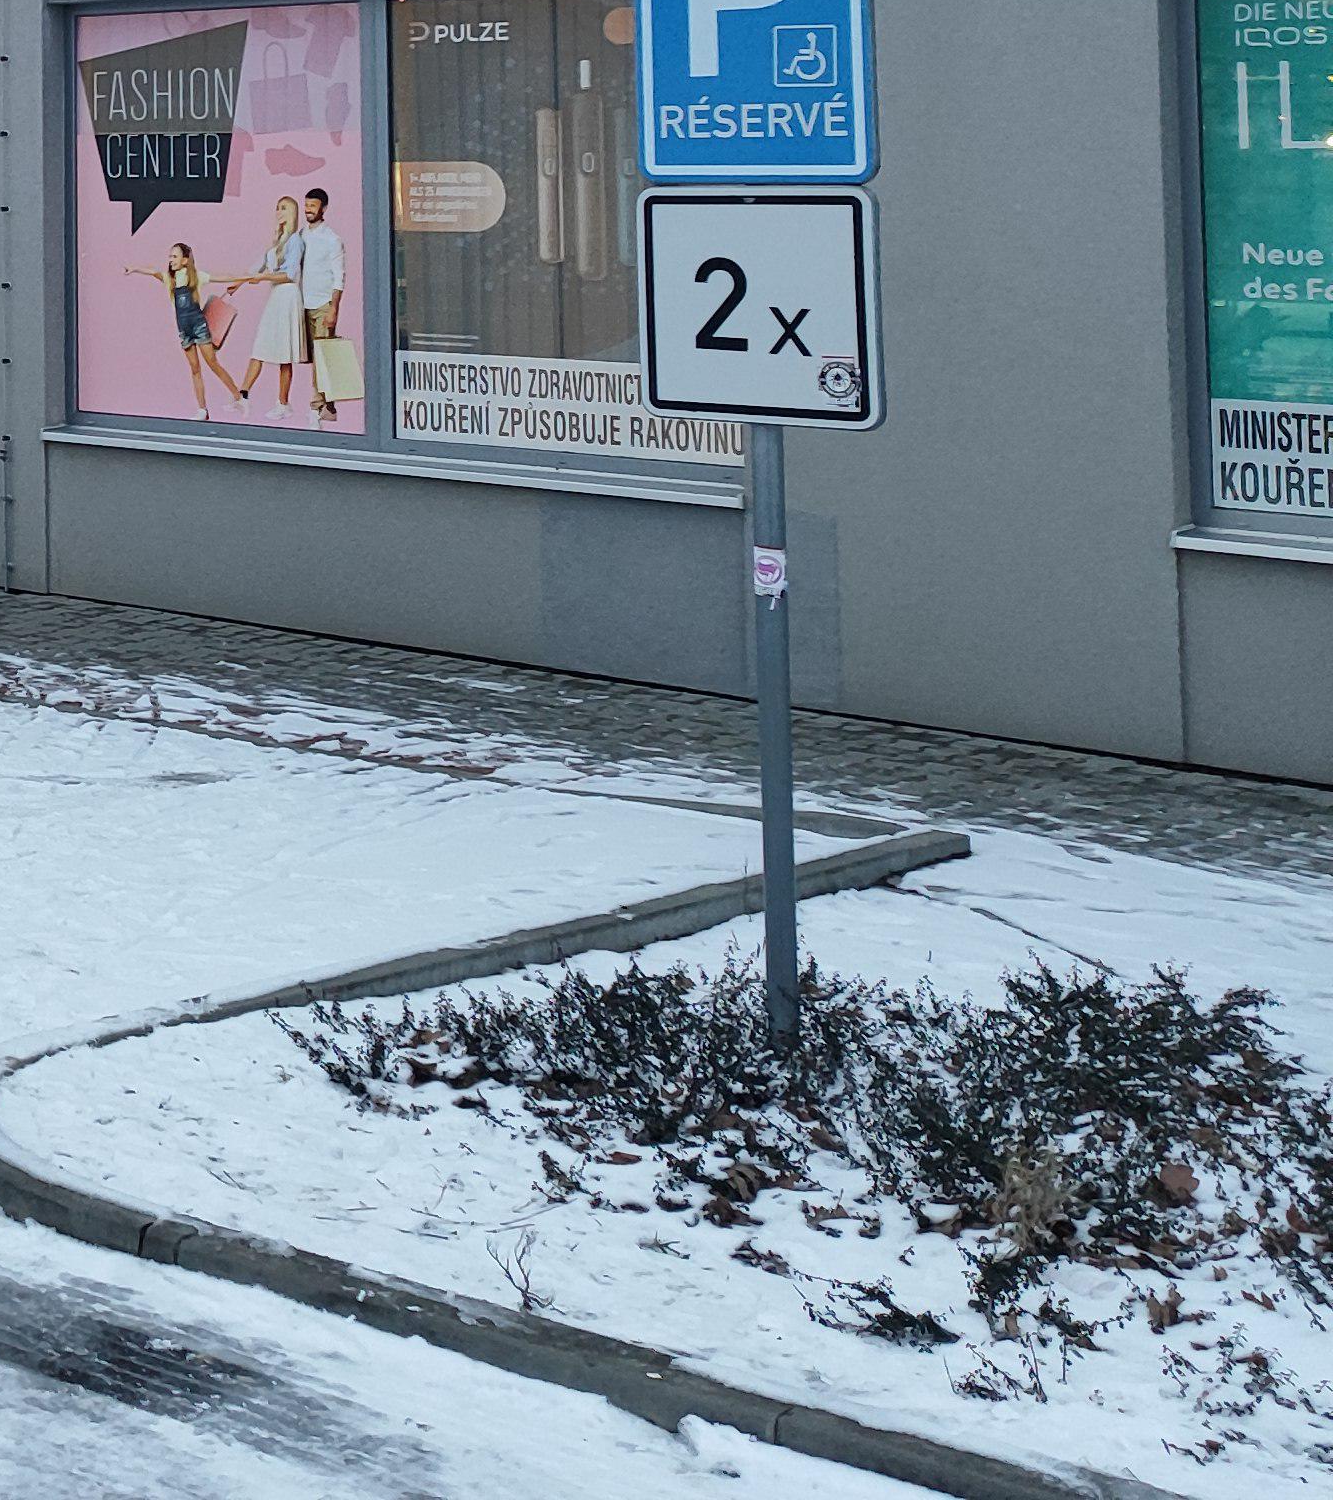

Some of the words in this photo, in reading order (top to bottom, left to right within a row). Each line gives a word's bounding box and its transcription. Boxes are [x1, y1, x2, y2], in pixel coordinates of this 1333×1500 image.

[1234, 2, 1277, 22] DIE
[434, 21, 510, 44] PULZE
[1235, 26, 1328, 48] IQOS
[93, 67, 234, 121] FASHION
[659, 92, 850, 140] RÉSERVÉ
[106, 133, 221, 179] CENTER
[1242, 242, 1324, 266] Neue
[694, 255, 748, 353] 2
[769, 306, 813, 358] x
[1243, 276, 1298, 300] des
[402, 360, 522, 398] MINISTERSTVO
[403, 398, 490, 435] KOUŘENÍ
[498, 403, 621, 447] ZPŮSOBUJE
[631, 416, 744, 456] RAKOVINU
